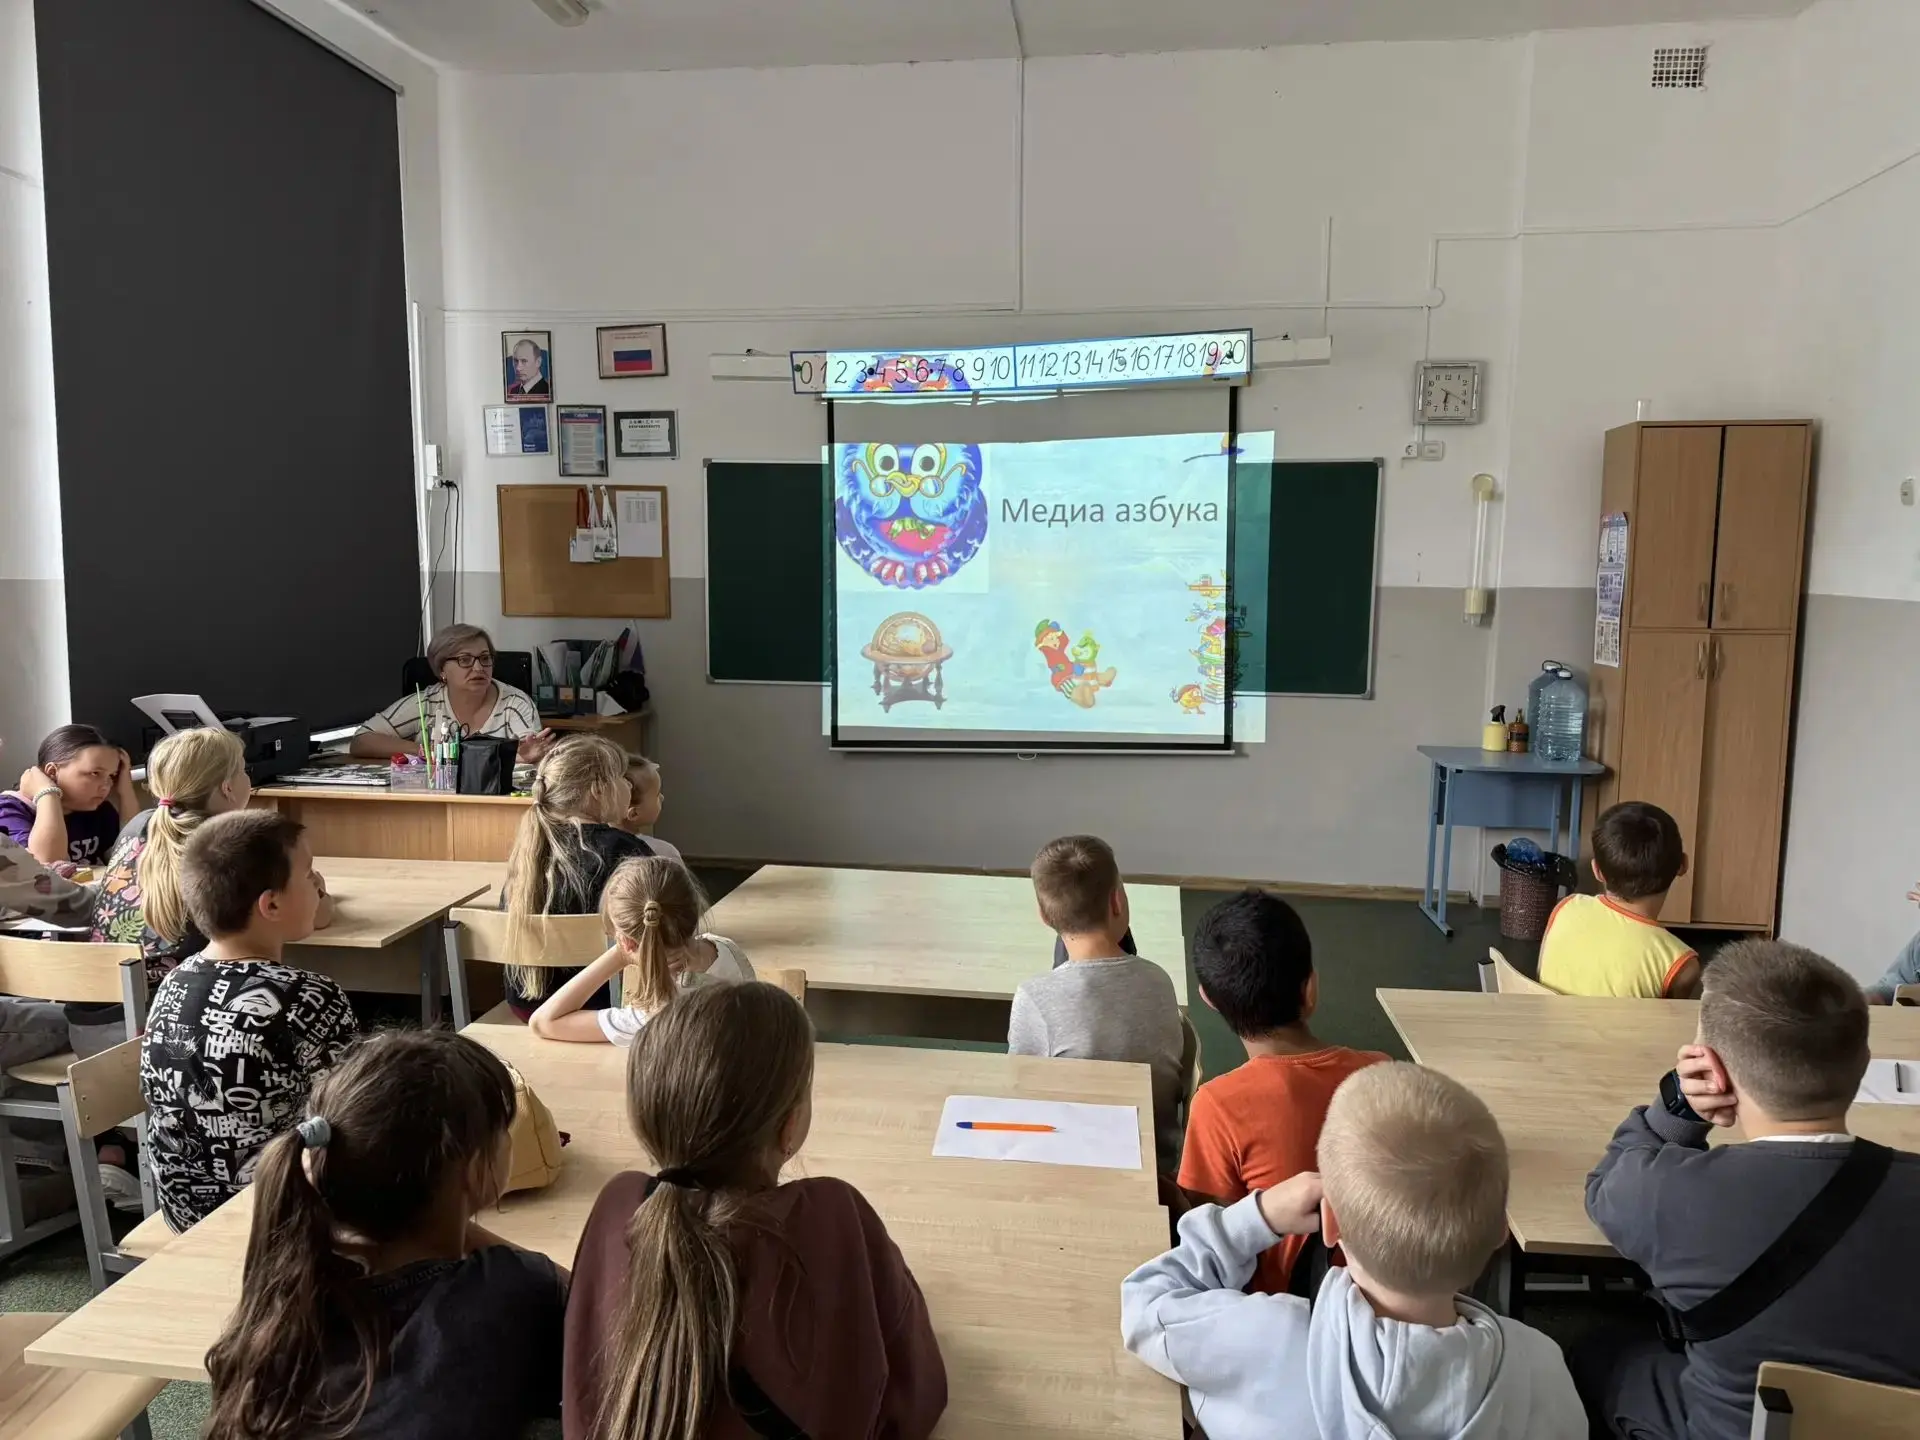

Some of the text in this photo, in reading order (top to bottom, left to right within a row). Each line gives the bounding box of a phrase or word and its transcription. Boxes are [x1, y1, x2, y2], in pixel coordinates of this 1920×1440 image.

[800, 339, 1246, 385] 0 1 2 3 4 5 6 7 8 9 10 11 12 13 14 15 16 17 18 19 20
[1002, 495, 1219, 528] Медиа азбука
